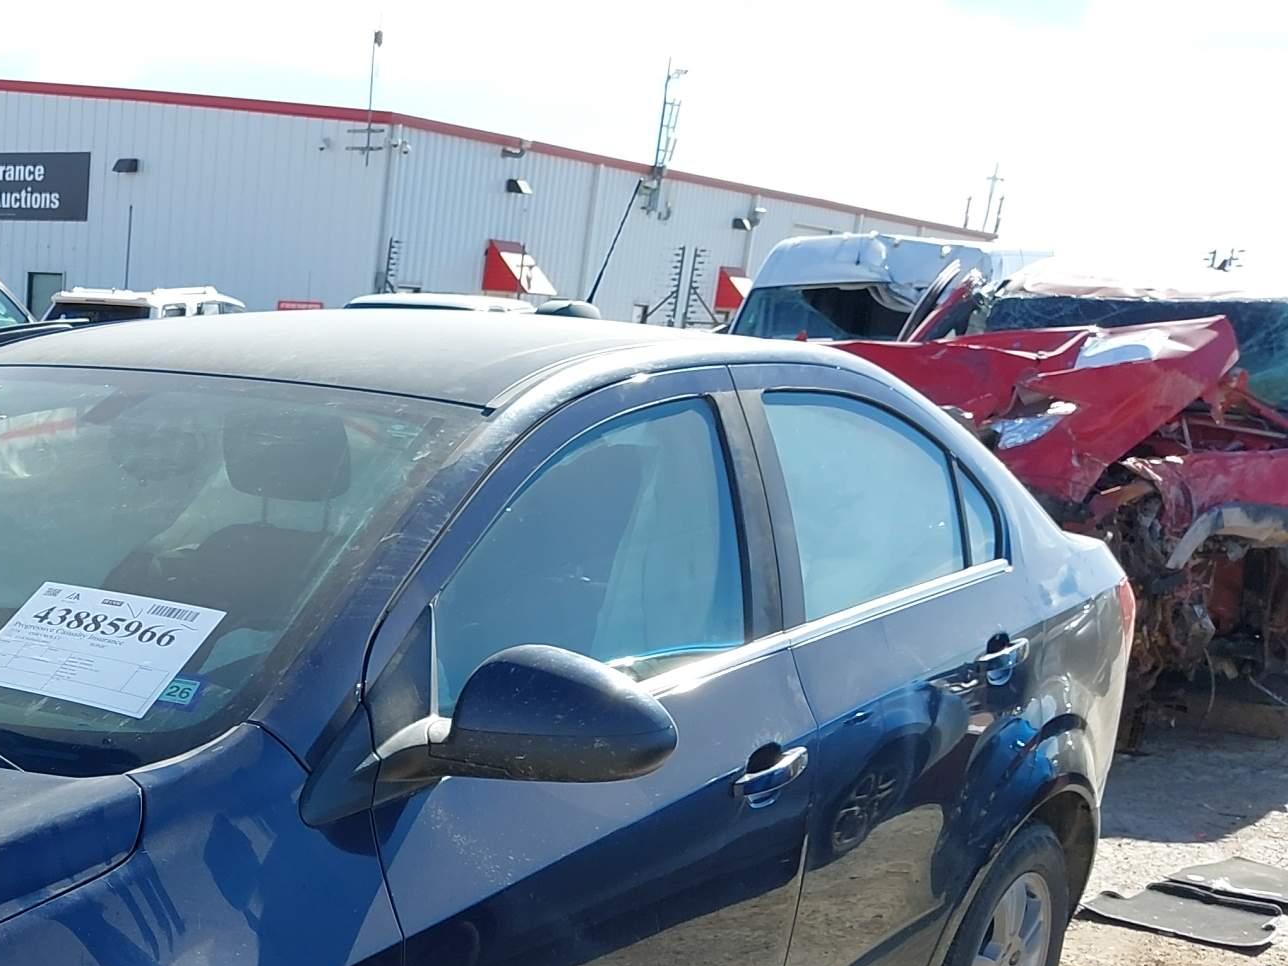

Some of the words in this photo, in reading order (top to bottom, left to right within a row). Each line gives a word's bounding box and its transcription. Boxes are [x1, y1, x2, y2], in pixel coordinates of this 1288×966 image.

[32, 605, 182, 647] 43885966
[88, 633, 126, 647] Insurance
[165, 685, 193, 700] 26
